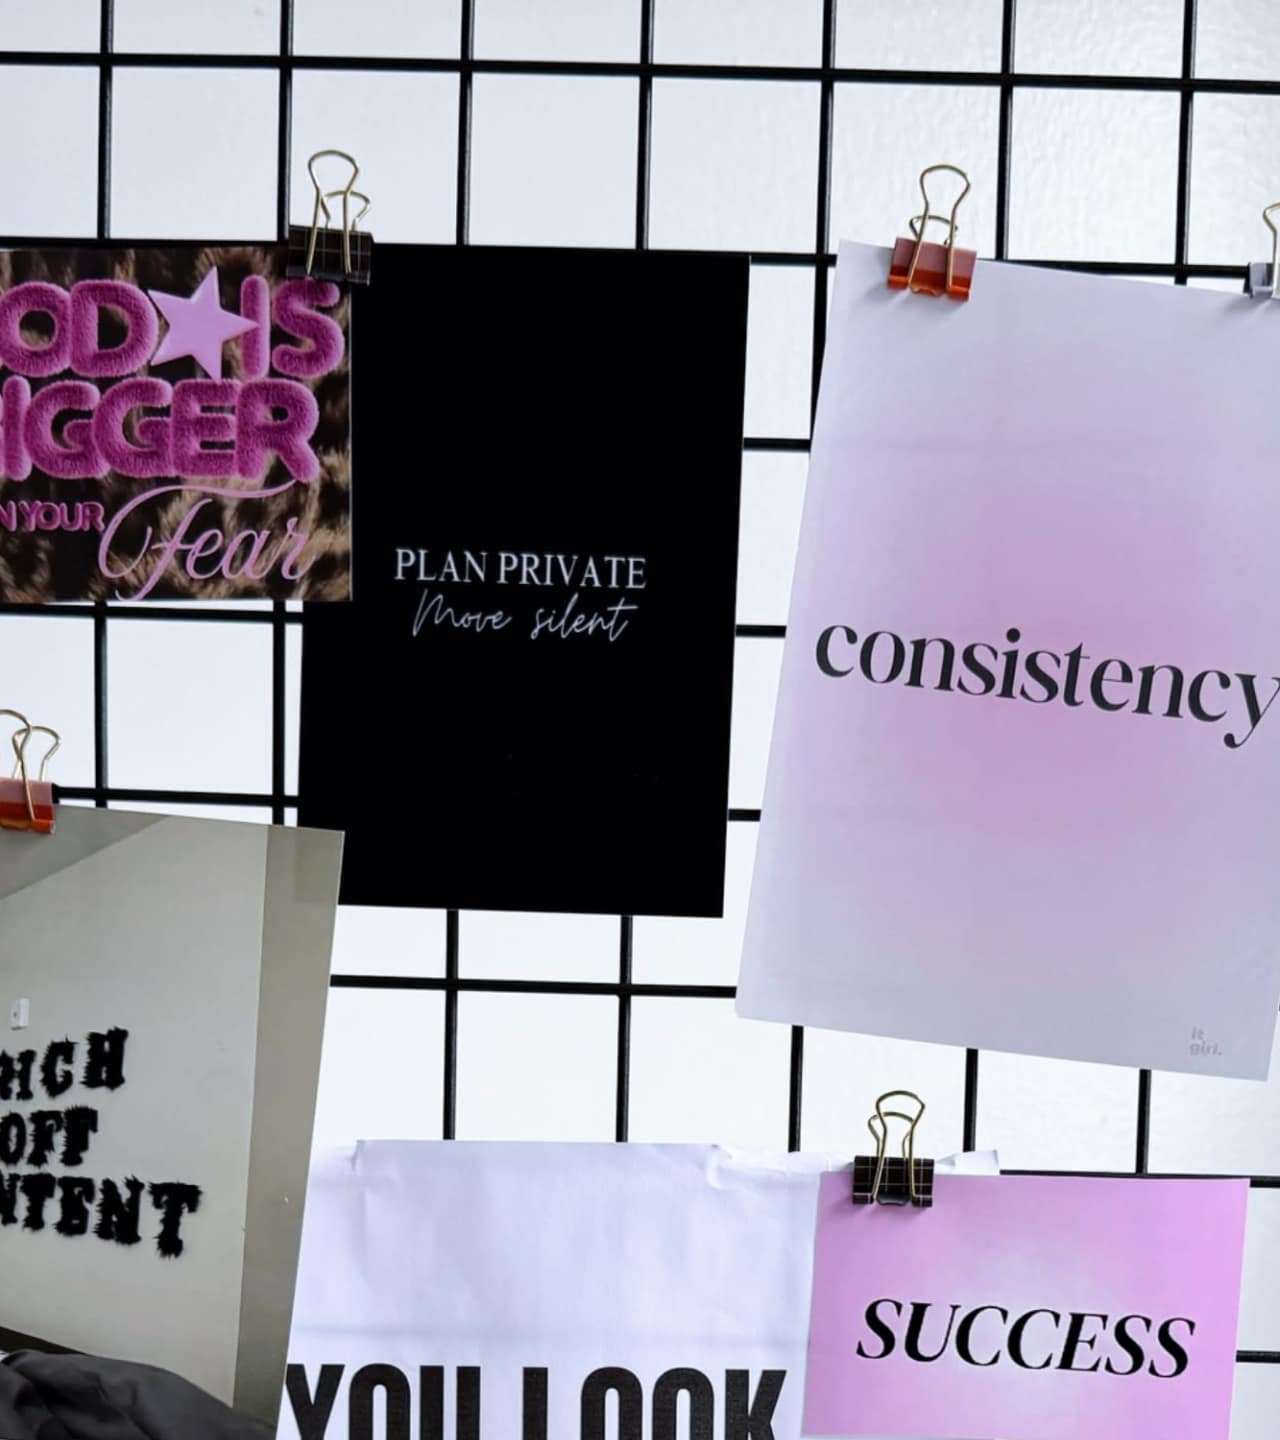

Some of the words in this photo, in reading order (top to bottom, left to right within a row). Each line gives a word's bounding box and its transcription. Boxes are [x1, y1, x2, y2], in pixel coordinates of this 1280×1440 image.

[240, 274, 345, 379] IS
[19, 500, 106, 533] YOUR
[97, 481, 316, 601] Fear
[395, 548, 489, 583] PLAN
[497, 551, 647, 590] PRIVATE
[411, 588, 514, 638] Move
[529, 596, 640, 643] silent
[854, 1297, 1197, 1379] SUCCESS
